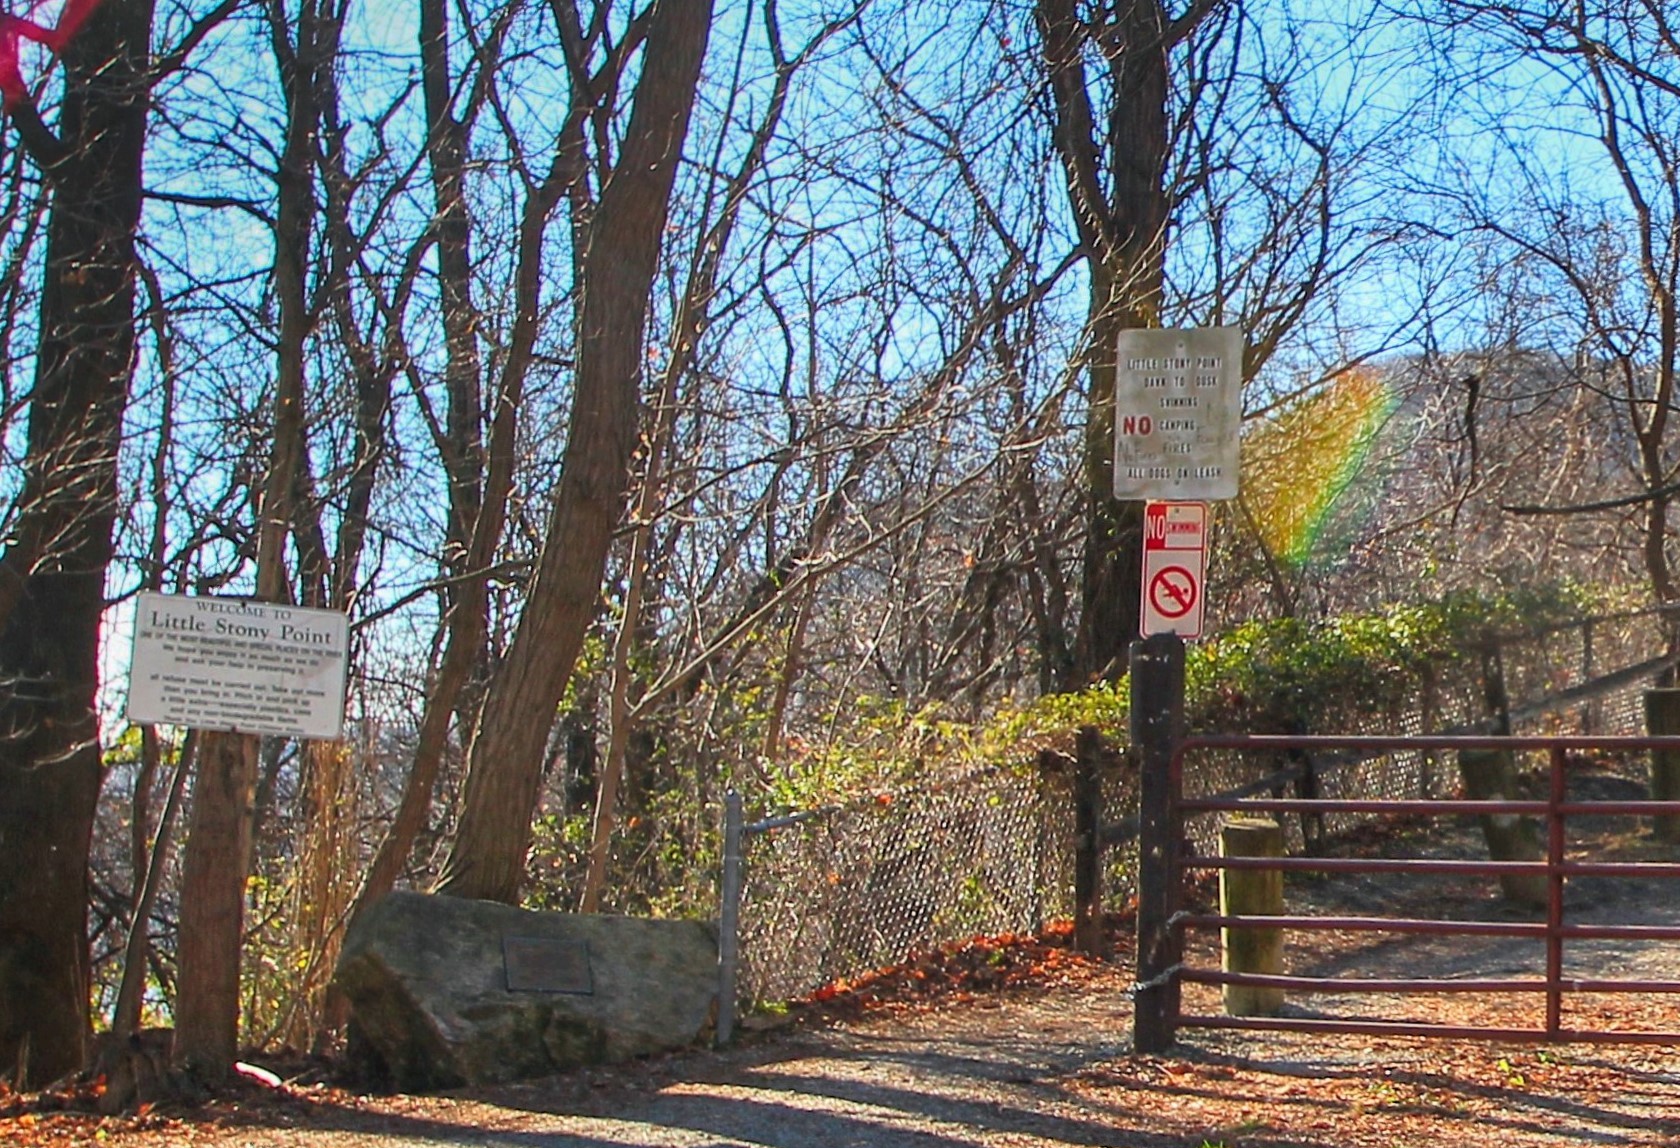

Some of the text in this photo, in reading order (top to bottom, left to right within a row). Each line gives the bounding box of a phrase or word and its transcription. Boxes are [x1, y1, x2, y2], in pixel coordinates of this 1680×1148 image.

[1128, 357, 1221, 369] LITTLE STONY POINT
[1144, 376, 1217, 388] DAWN TO DUSK
[1160, 397, 1198, 408] SWIMMING
[1123, 415, 1195, 436] NO CAMPING
[1128, 467, 1221, 478] ALL DOGS ON LEASH
[1147, 515, 1165, 539] NO
[196, 601, 292, 621] WELCOME TO
[150, 610, 332, 645] Little Stony Point
